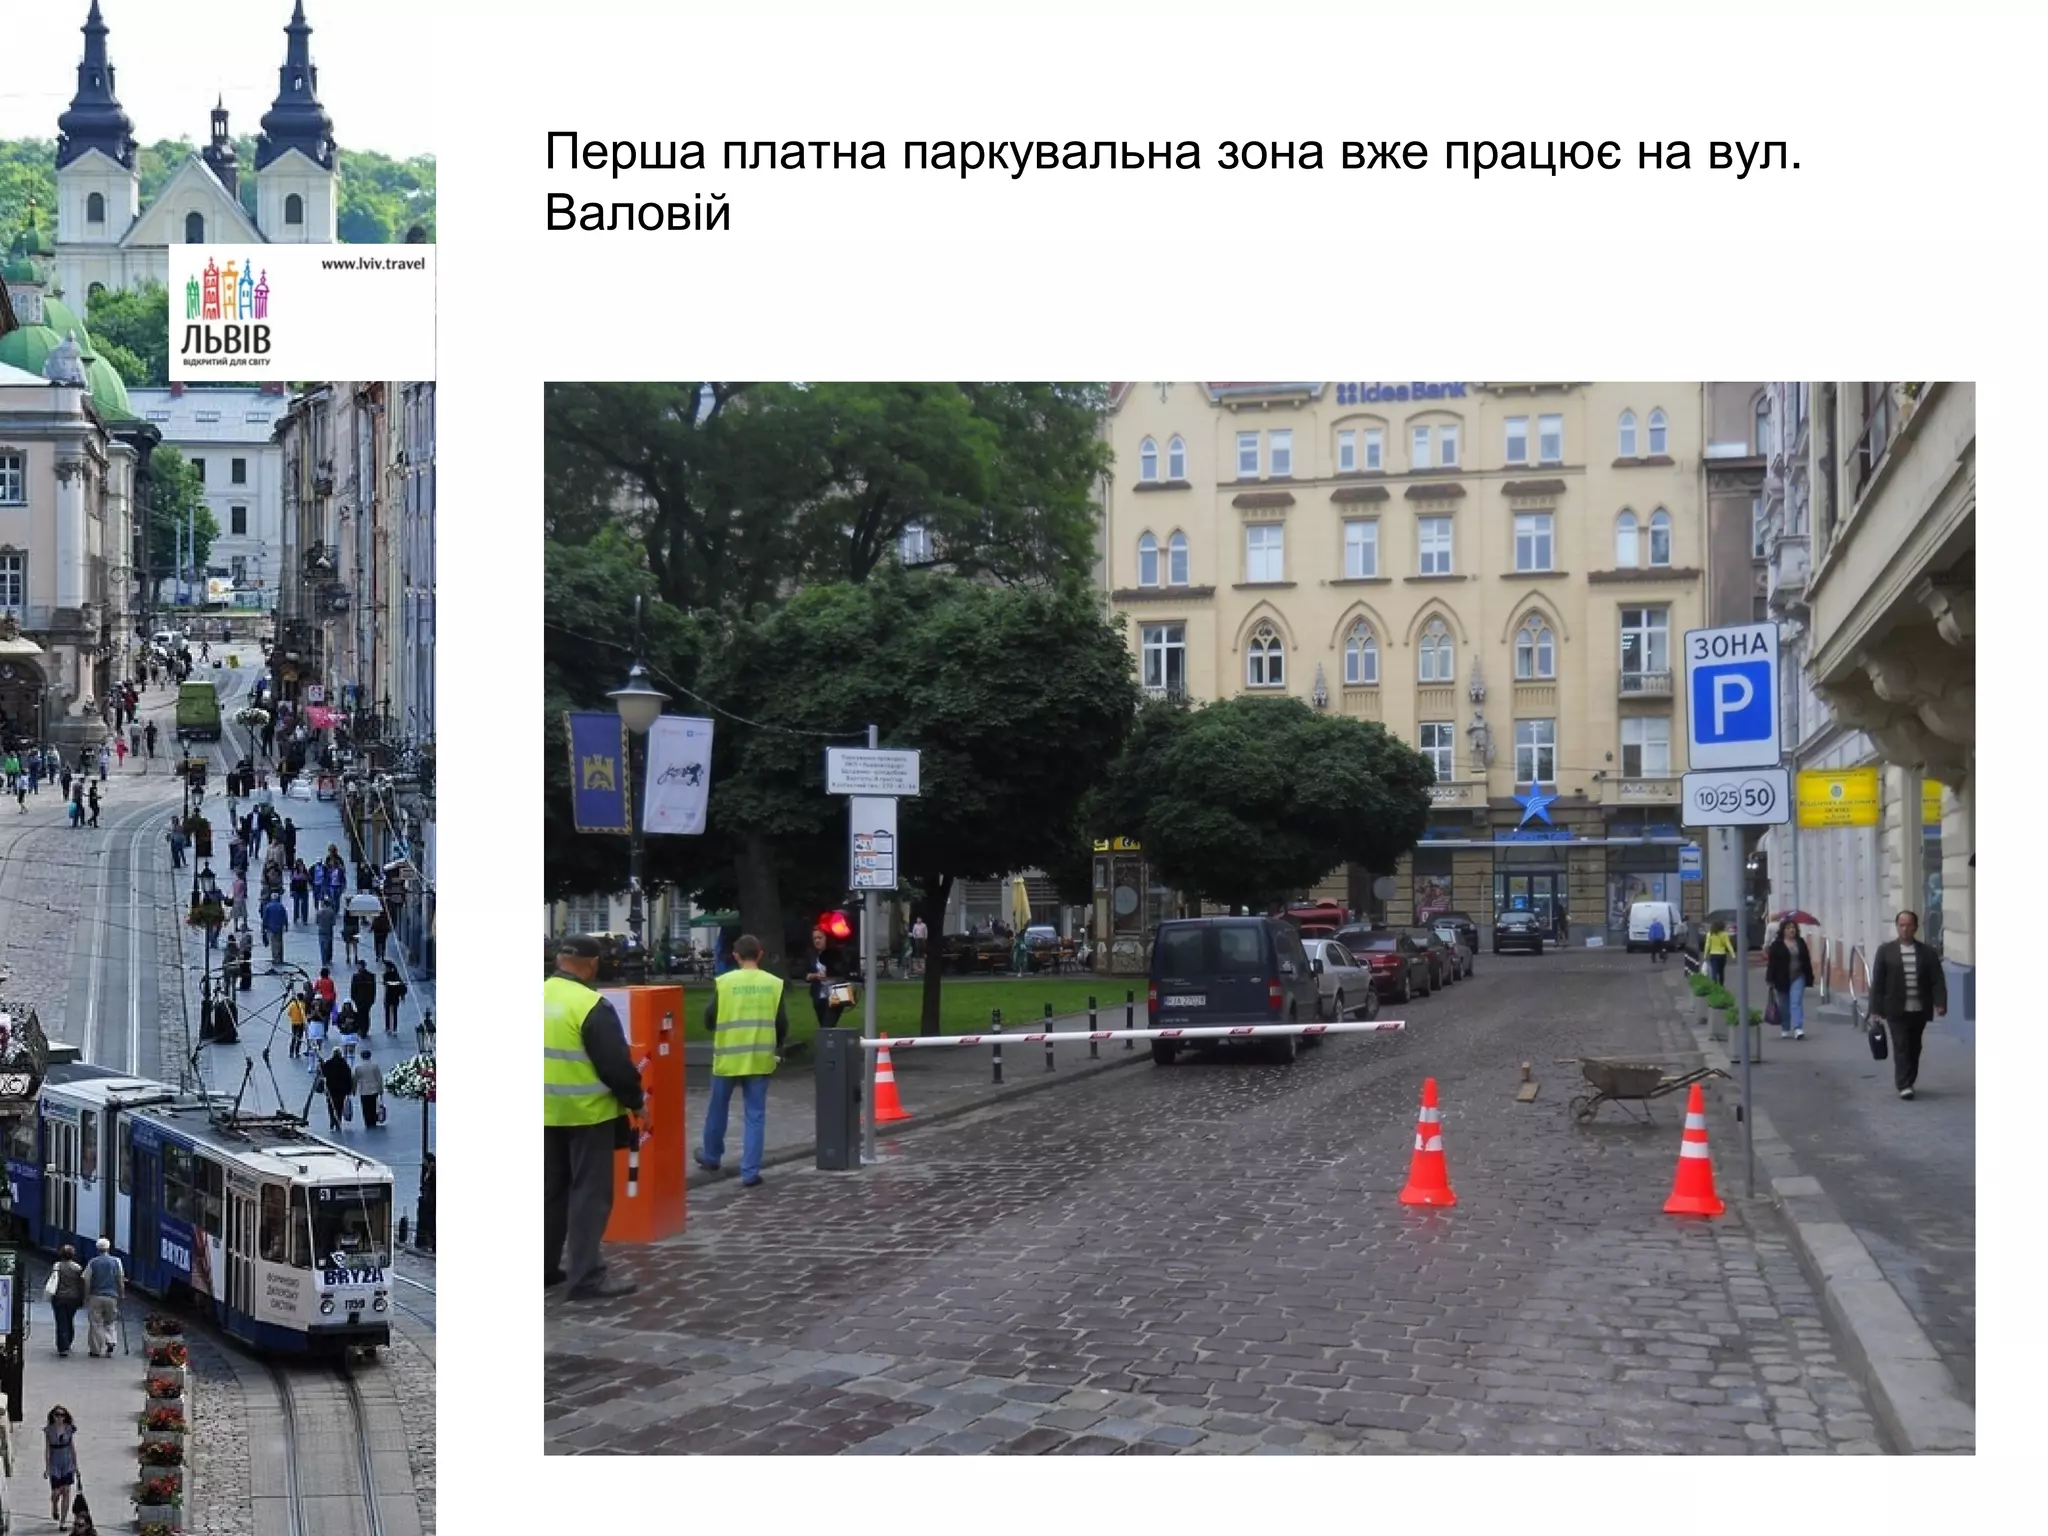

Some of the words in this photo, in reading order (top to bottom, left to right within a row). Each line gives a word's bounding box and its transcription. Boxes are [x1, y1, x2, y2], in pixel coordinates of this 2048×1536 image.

[1694, 632, 1768, 660] ЗОНА
[1713, 674, 1753, 736] P
[1699, 792, 1714, 806] 10
[1719, 790, 1738, 806] 25
[1744, 788, 1769, 807] 50
